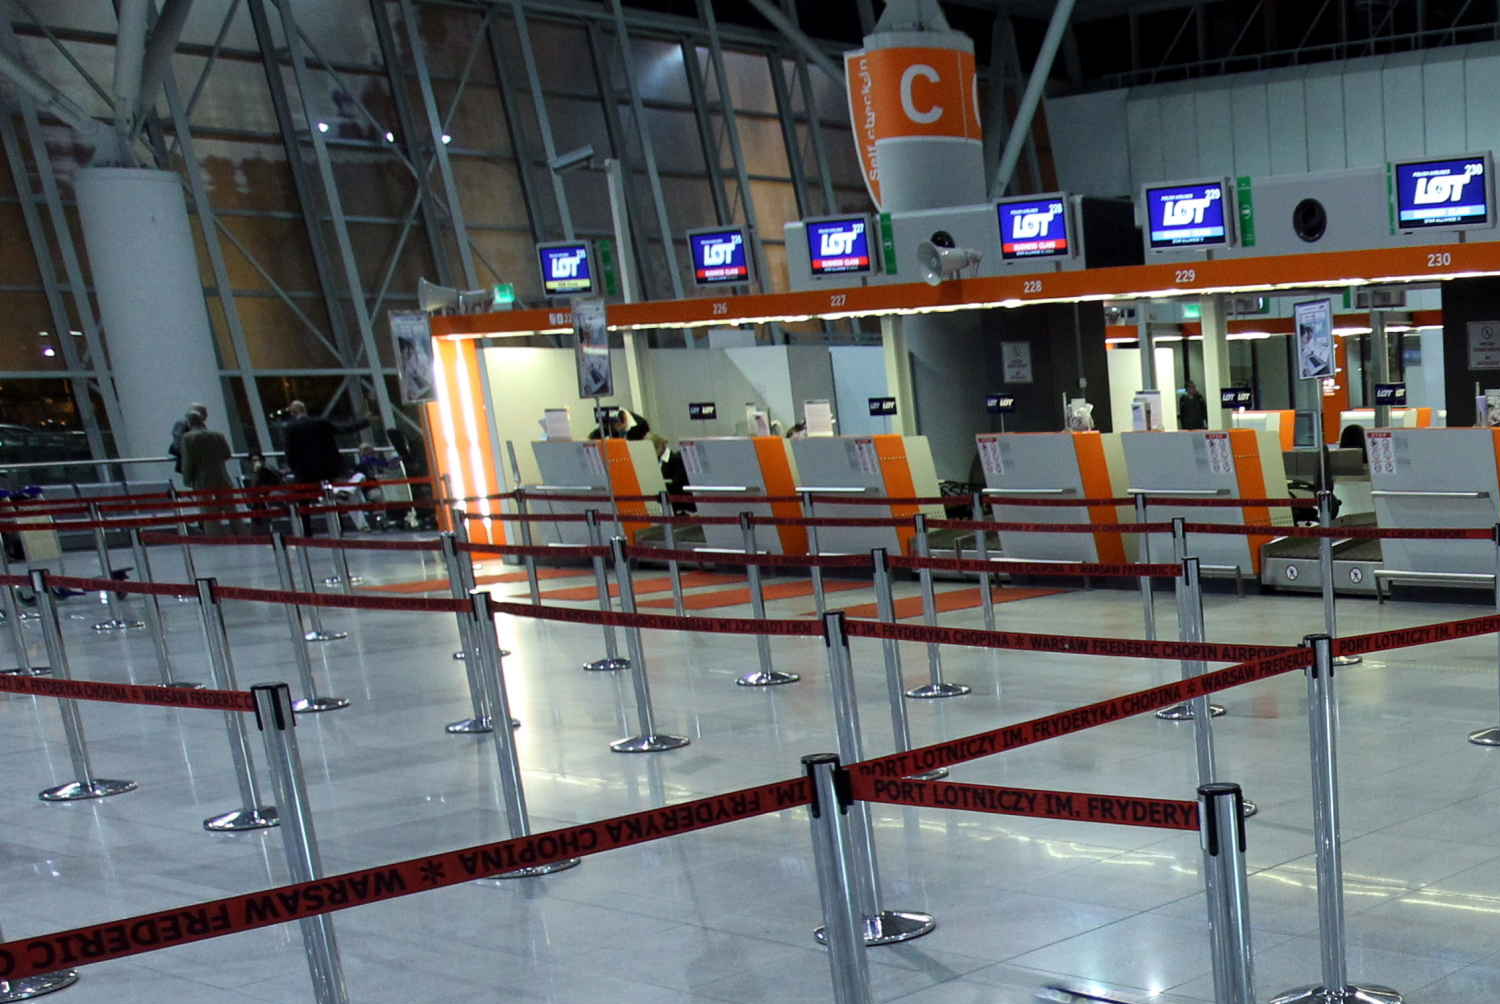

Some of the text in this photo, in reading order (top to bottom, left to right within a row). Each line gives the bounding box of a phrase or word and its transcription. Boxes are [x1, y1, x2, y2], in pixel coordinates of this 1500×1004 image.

[900, 64, 943, 124] C
[1464, 163, 1483, 177] 230
[1204, 188, 1221, 201] 229
[1413, 173, 1471, 205] LOT
[1012, 212, 1055, 239] LOT
[1162, 198, 1211, 227] LOT
[703, 242, 736, 266] LOT
[820, 231, 857, 257] LOT
[551, 256, 581, 278] LOT
[1427, 253, 1451, 267] 230
[1023, 280, 1042, 293] 228
[1175, 269, 1196, 283] 229
[712, 302, 728, 315] 226
[830, 294, 847, 307] 227
[1376, 389, 1393, 397] LOT
[1392, 529, 1426, 538] CHOPIN
[1024, 562, 1065, 573] CHOPINA
[1080, 564, 1120, 574] WARSAW
[1122, 565, 1169, 576] FREDERIC
[862, 624, 880, 636] IM.
[882, 625, 950, 642] FRYDERYKA
[953, 631, 1010, 647] CHOPINA
[1031, 637, 1088, 652] WARSAW
[1092, 641, 1159, 657] FREDERIC
[1163, 643, 1218, 660] CHOPIN
[1340, 635, 1371, 655] PORT
[1374, 628, 1431, 650] LOTNICZY
[1434, 624, 1451, 642] IM.
[30, 679, 83, 696] FRYDERYKA
[85, 684, 128, 700] CHOPINA
[143, 688, 188, 705] WARSAW
[191, 691, 243, 708] FREDERIC
[913, 736, 997, 771] LOTNICZY
[1002, 728, 1028, 747] IM.
[1032, 704, 1119, 741] FRYDERYKA
[1122, 688, 1182, 714] CHOPINA
[1201, 666, 1257, 692] WARSAW
[1259, 651, 1312, 674] FREDERIC
[874, 779, 1200, 827] PORT LOTNICZY IM. FRYDERY
[606, 792, 761, 843] FRYDERYKA
[458, 827, 598, 876] CHOPINA
[244, 868, 407, 925] WARSAW
[26, 904, 230, 970] FREDERIC
